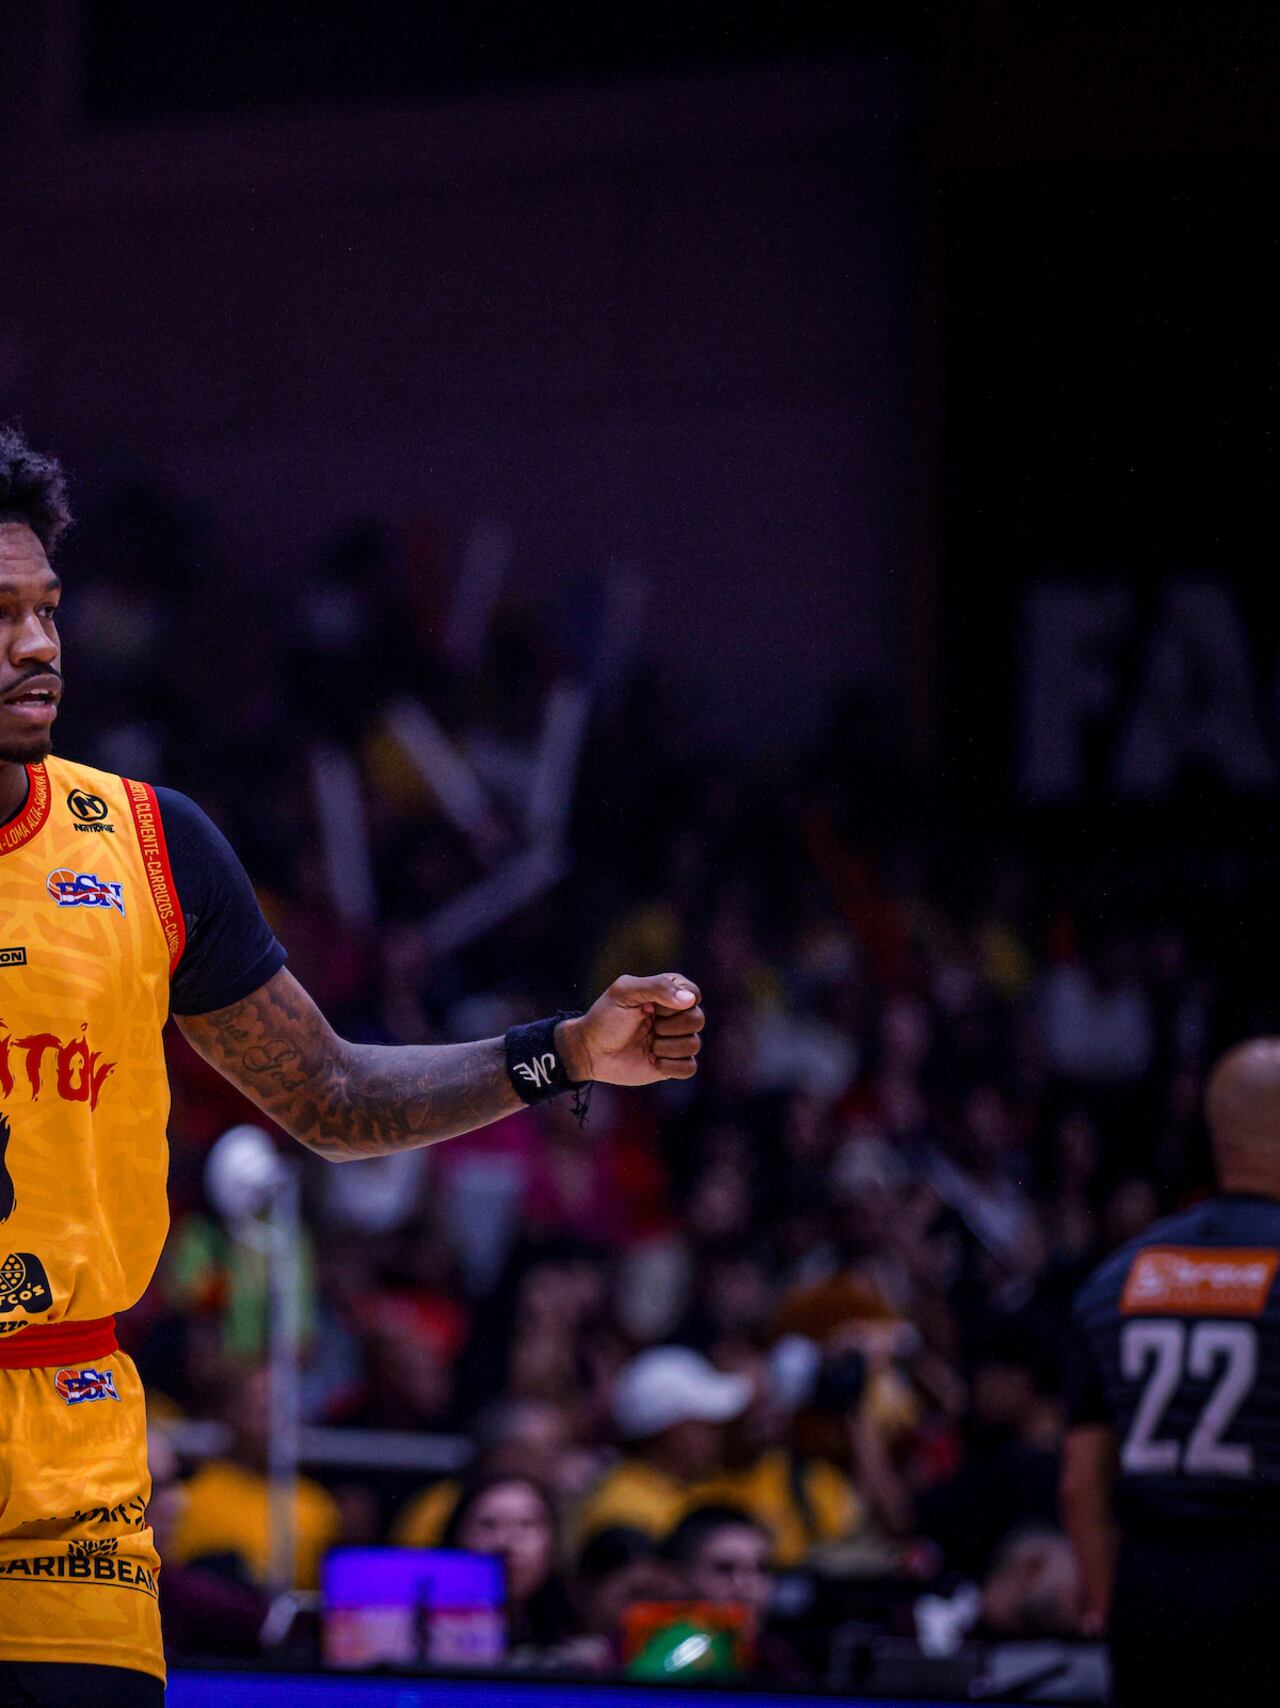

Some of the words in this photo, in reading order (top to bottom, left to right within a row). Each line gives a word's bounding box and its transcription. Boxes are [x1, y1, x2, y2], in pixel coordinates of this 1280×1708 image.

[1017, 575, 1280, 803] FA
[55, 873, 126, 917] BSN
[63, 1368, 120, 1404] BSN
[1121, 1318, 1258, 1474] 22
